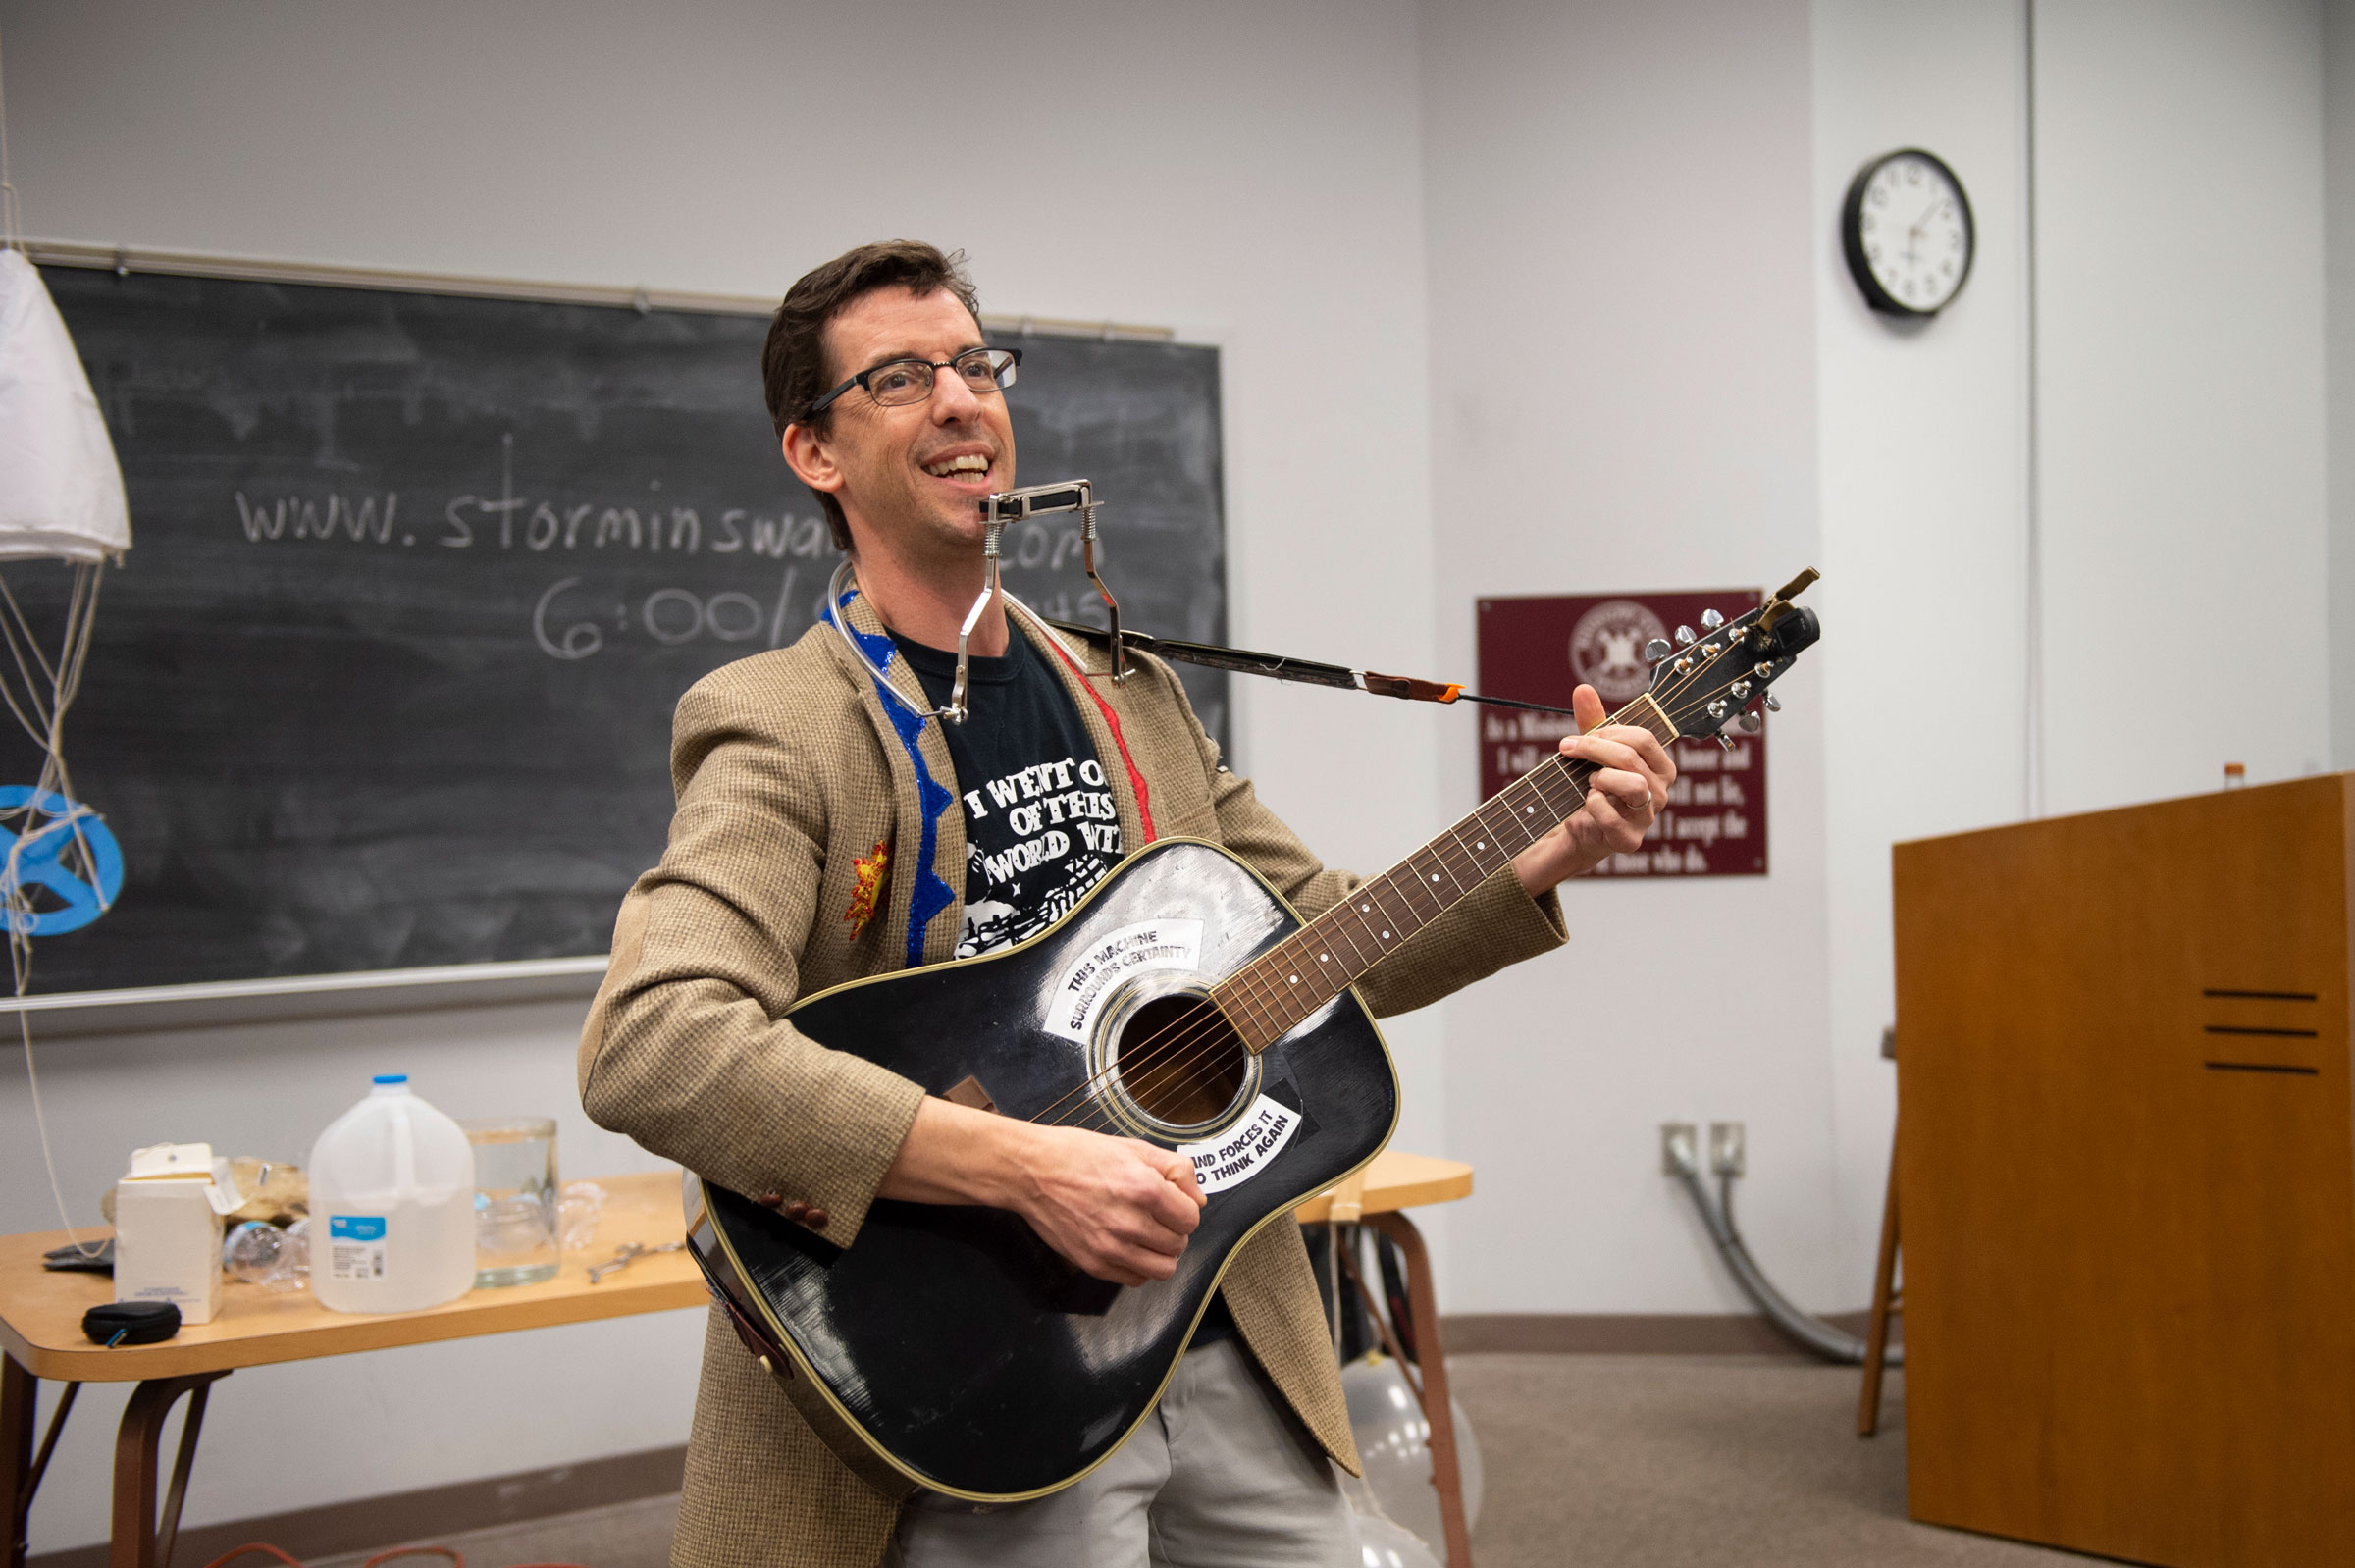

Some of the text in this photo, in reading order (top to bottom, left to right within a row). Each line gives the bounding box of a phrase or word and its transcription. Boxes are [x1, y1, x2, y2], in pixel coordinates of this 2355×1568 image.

[963, 757, 1109, 819] I WENT O
[1009, 789, 1116, 836] OF THIS
[984, 830, 1070, 883] WORLD
[1068, 930, 1158, 992] THIS MACHINE
[1070, 945, 1191, 1030] SURROUNDS CERTAINTY
[1211, 1153, 1255, 1181] THINK
[1254, 1114, 1289, 1158] AGAIN
[1218, 1124, 1263, 1162] FORCES
[1258, 1109, 1273, 1125] IT
